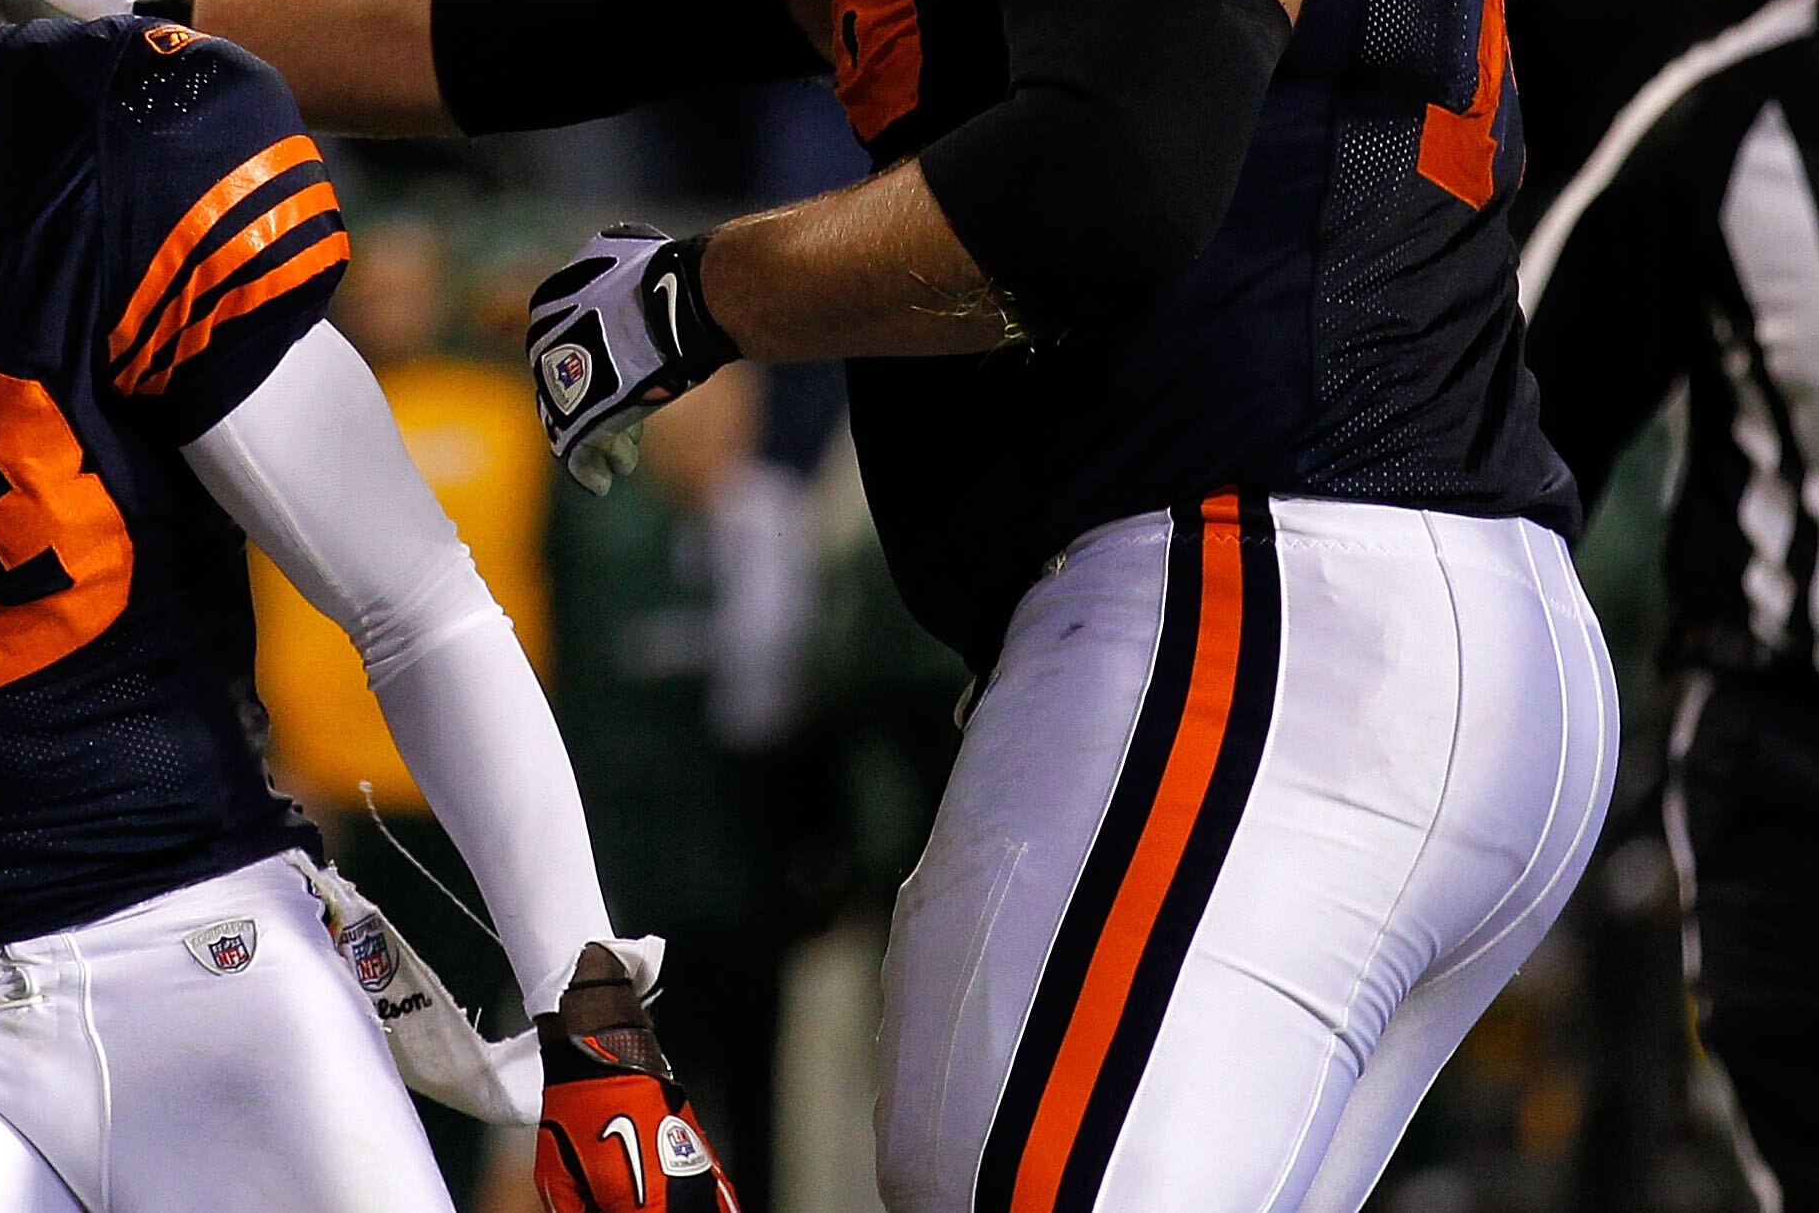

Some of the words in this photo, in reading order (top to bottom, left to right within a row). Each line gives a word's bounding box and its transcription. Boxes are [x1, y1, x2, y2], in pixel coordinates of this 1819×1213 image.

[217, 947, 246, 966] NFL
[359, 953, 389, 980] NFL
[378, 993, 424, 1019] lson
